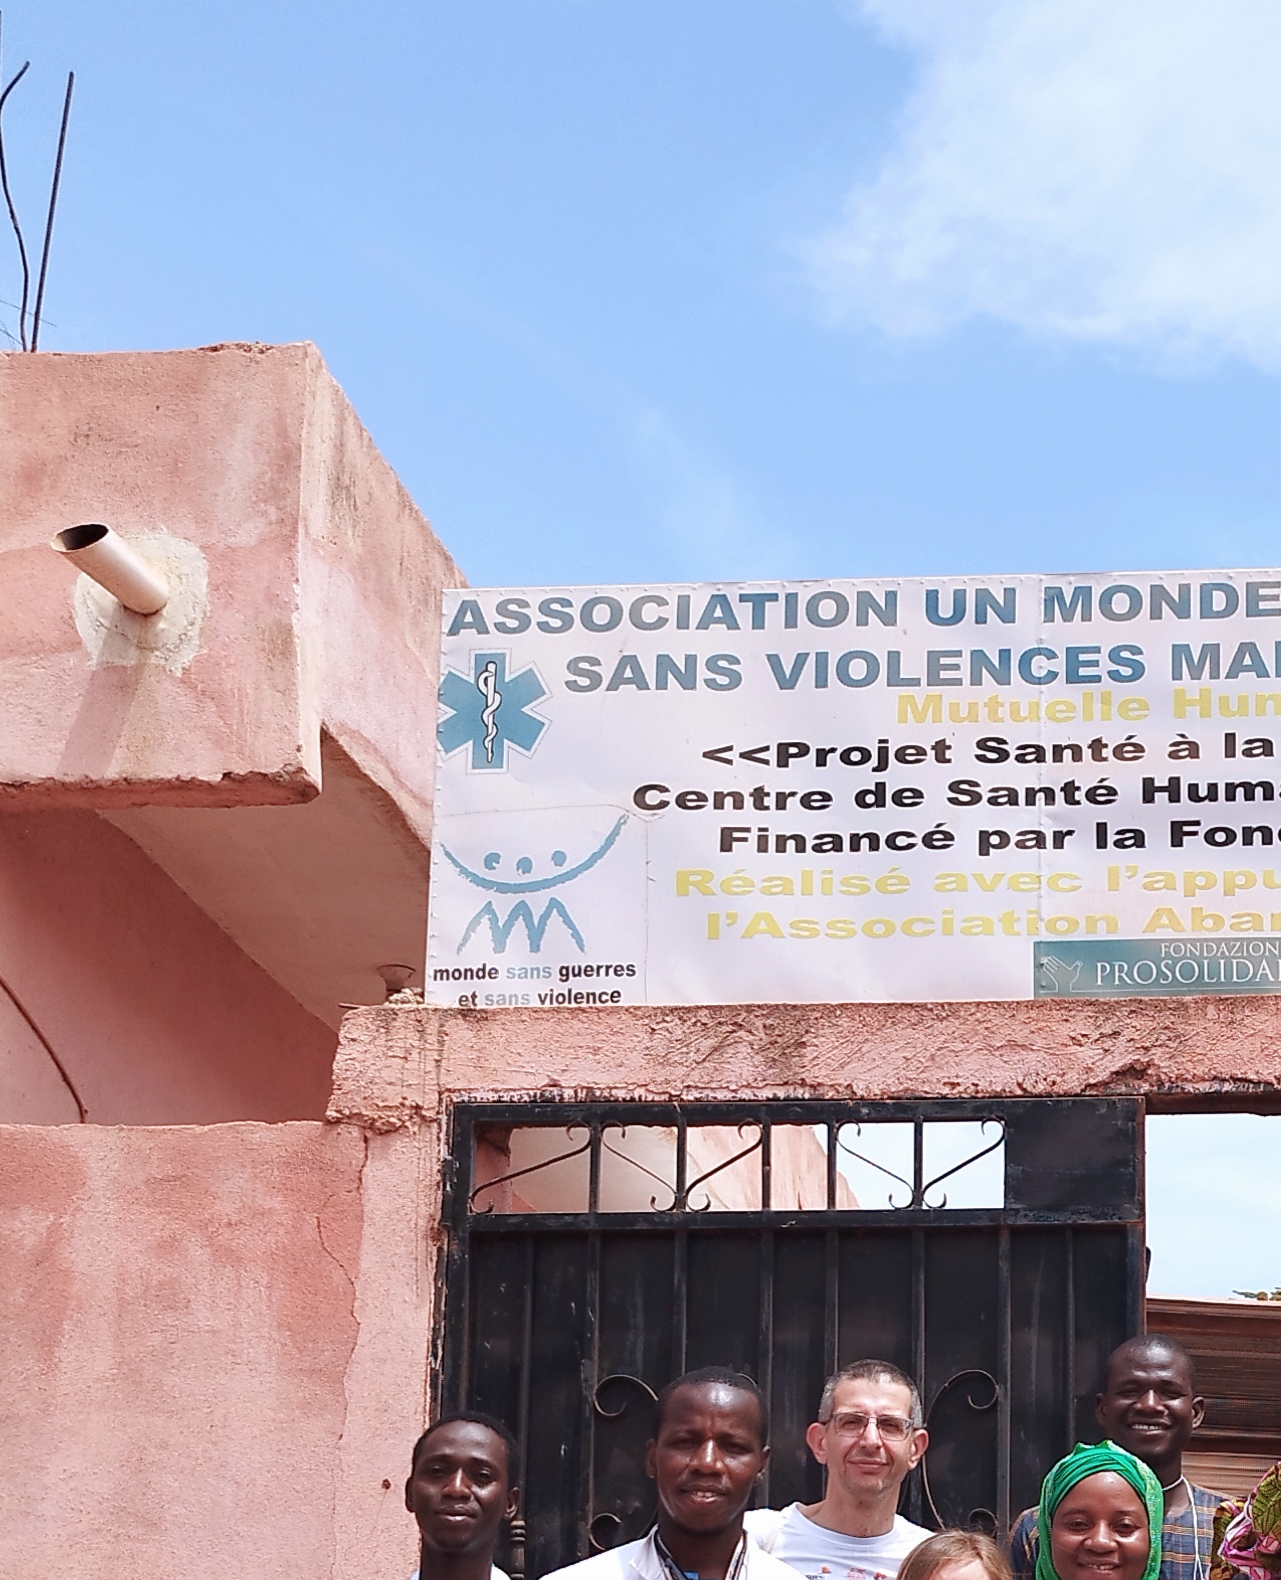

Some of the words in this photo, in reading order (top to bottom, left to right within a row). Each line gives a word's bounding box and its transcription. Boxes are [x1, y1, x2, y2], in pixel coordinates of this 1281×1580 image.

[446, 590, 898, 637] ASSOCIATION
[925, 587, 1017, 627] UN
[1043, 581, 1281, 624] MONDE
[564, 653, 743, 693] SANS
[765, 644, 1146, 691] VIOLENCES
[897, 689, 1150, 724] Mutuelle
[973, 734, 1146, 765] Santé
[1167, 733, 1201, 761] à
[1224, 731, 1275, 759] la
[632, 783, 834, 812] Centre
[854, 781, 925, 810] de
[946, 777, 1119, 807] Santé
[719, 822, 956, 854] Financé
[978, 829, 1076, 857] par
[1095, 821, 1147, 850] la
[675, 868, 910, 896] Réalisé
[933, 871, 1079, 893] avec
[432, 963, 499, 982] monde
[506, 965, 553, 980] sans
[558, 963, 637, 983] guerres
[458, 990, 478, 1007] et
[484, 992, 531, 1006] sans
[537, 988, 622, 1006] violence
